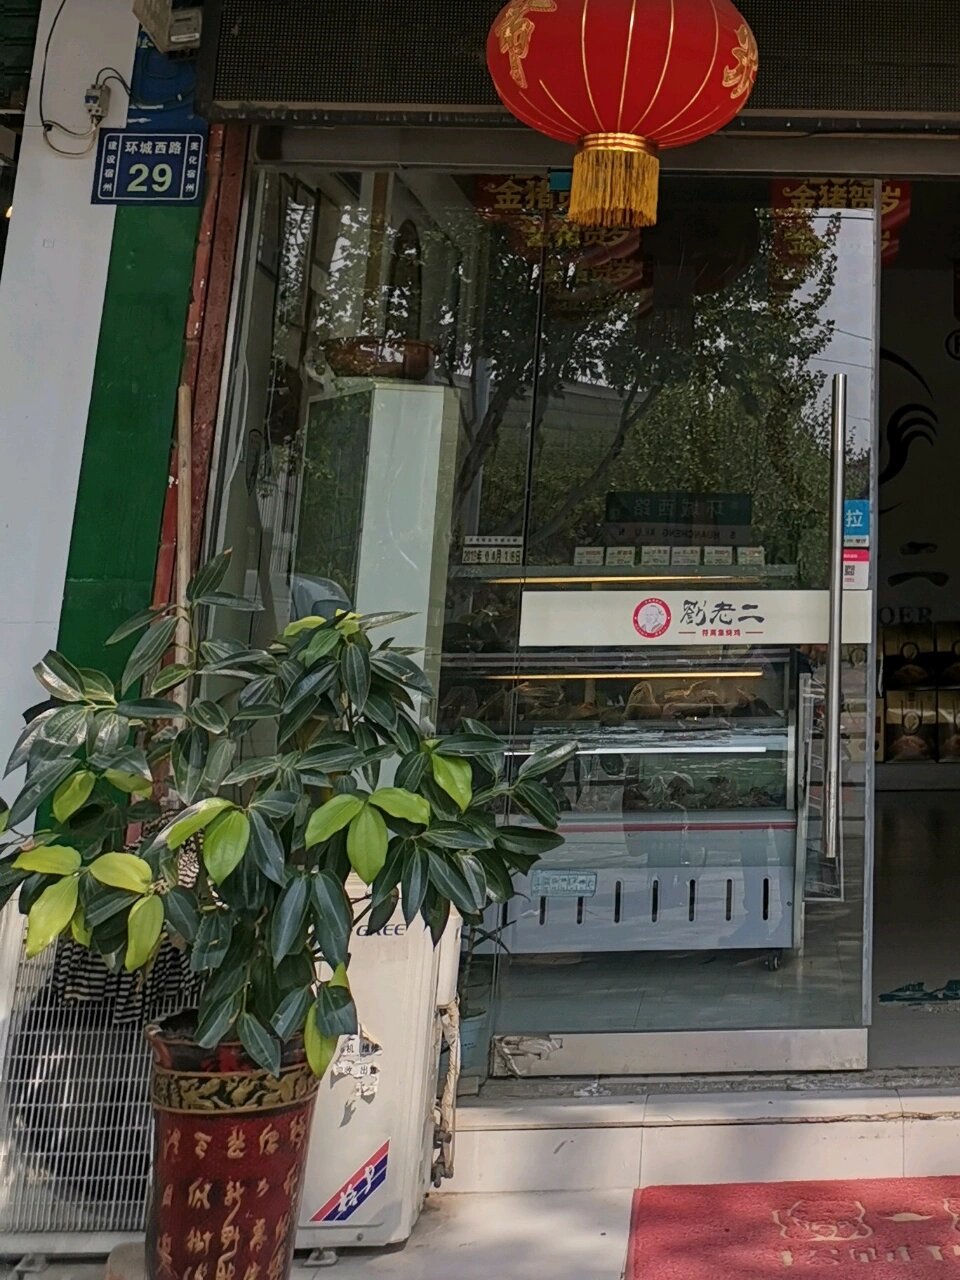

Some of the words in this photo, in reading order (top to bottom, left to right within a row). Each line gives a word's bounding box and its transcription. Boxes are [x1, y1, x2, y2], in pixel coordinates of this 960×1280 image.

[124, 141, 182, 155] 环城西路
[185, 141, 199, 192] 美化宿州
[126, 163, 173, 192] 29
[845, 509, 863, 527] 拉
[356, 924, 406, 937] GEE
